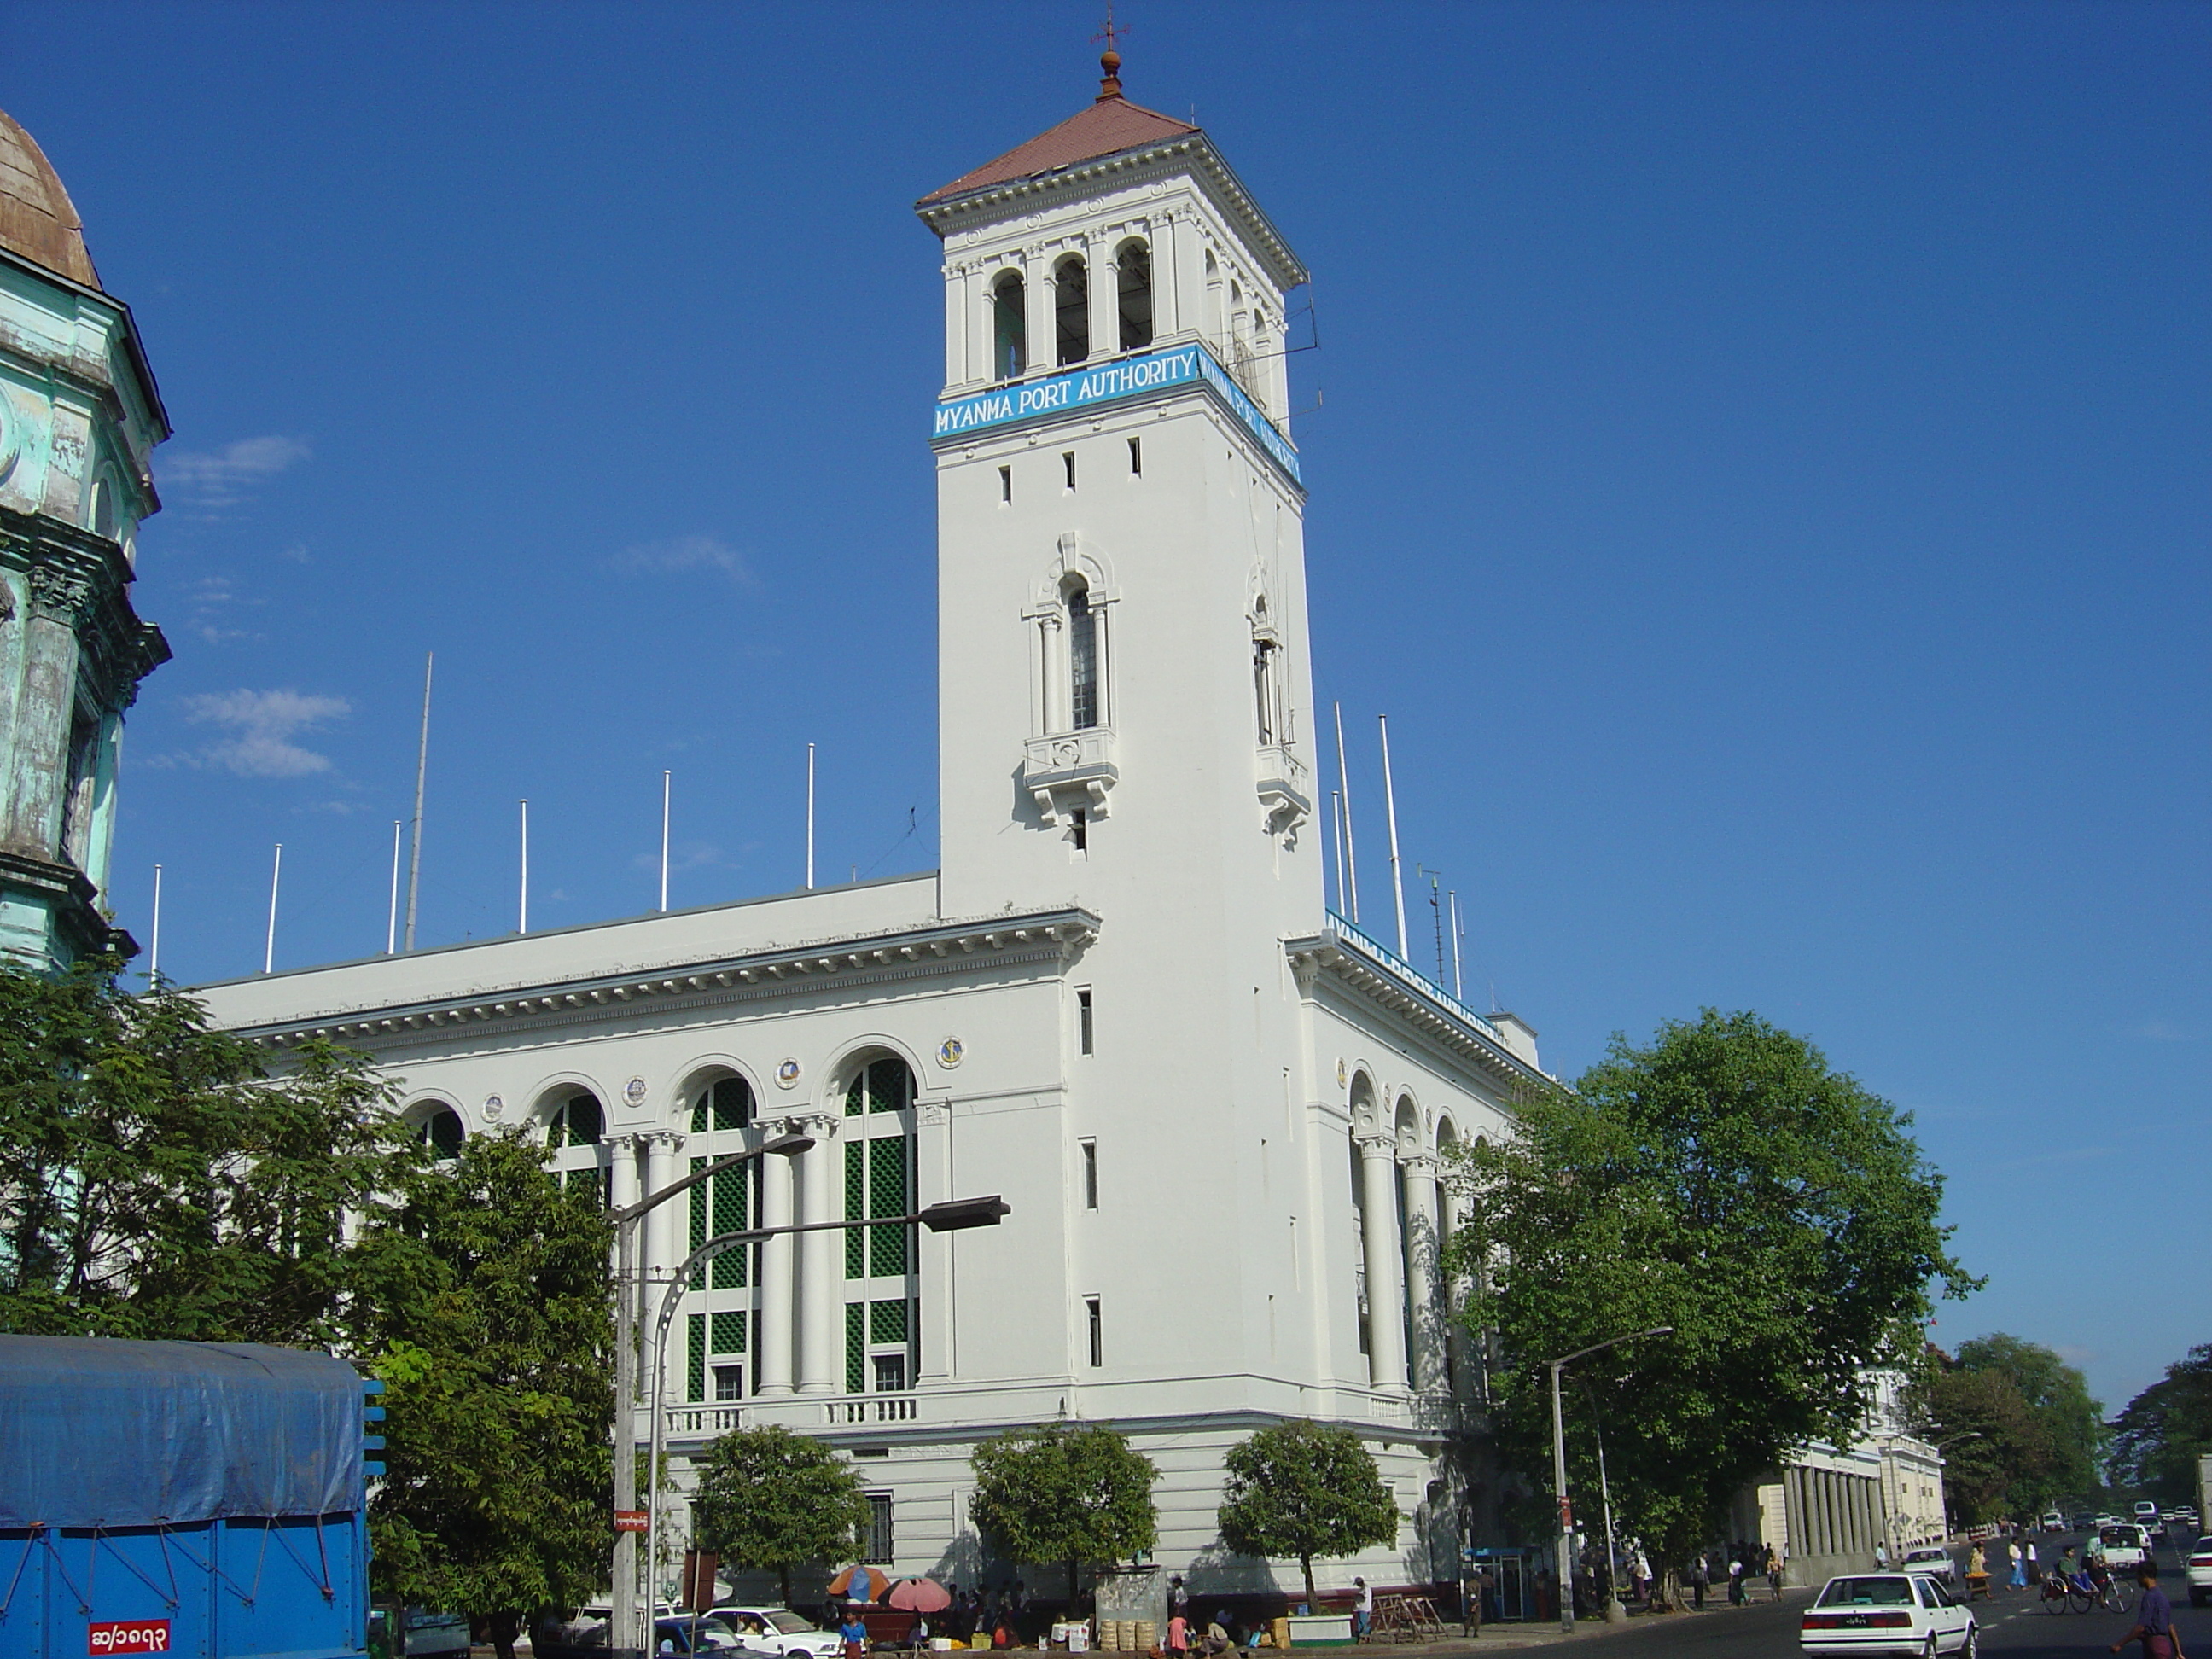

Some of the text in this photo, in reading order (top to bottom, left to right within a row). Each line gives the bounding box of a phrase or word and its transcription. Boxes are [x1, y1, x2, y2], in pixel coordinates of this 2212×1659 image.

[935, 351, 1195, 433] MYANMA PORT AUTHORITY
